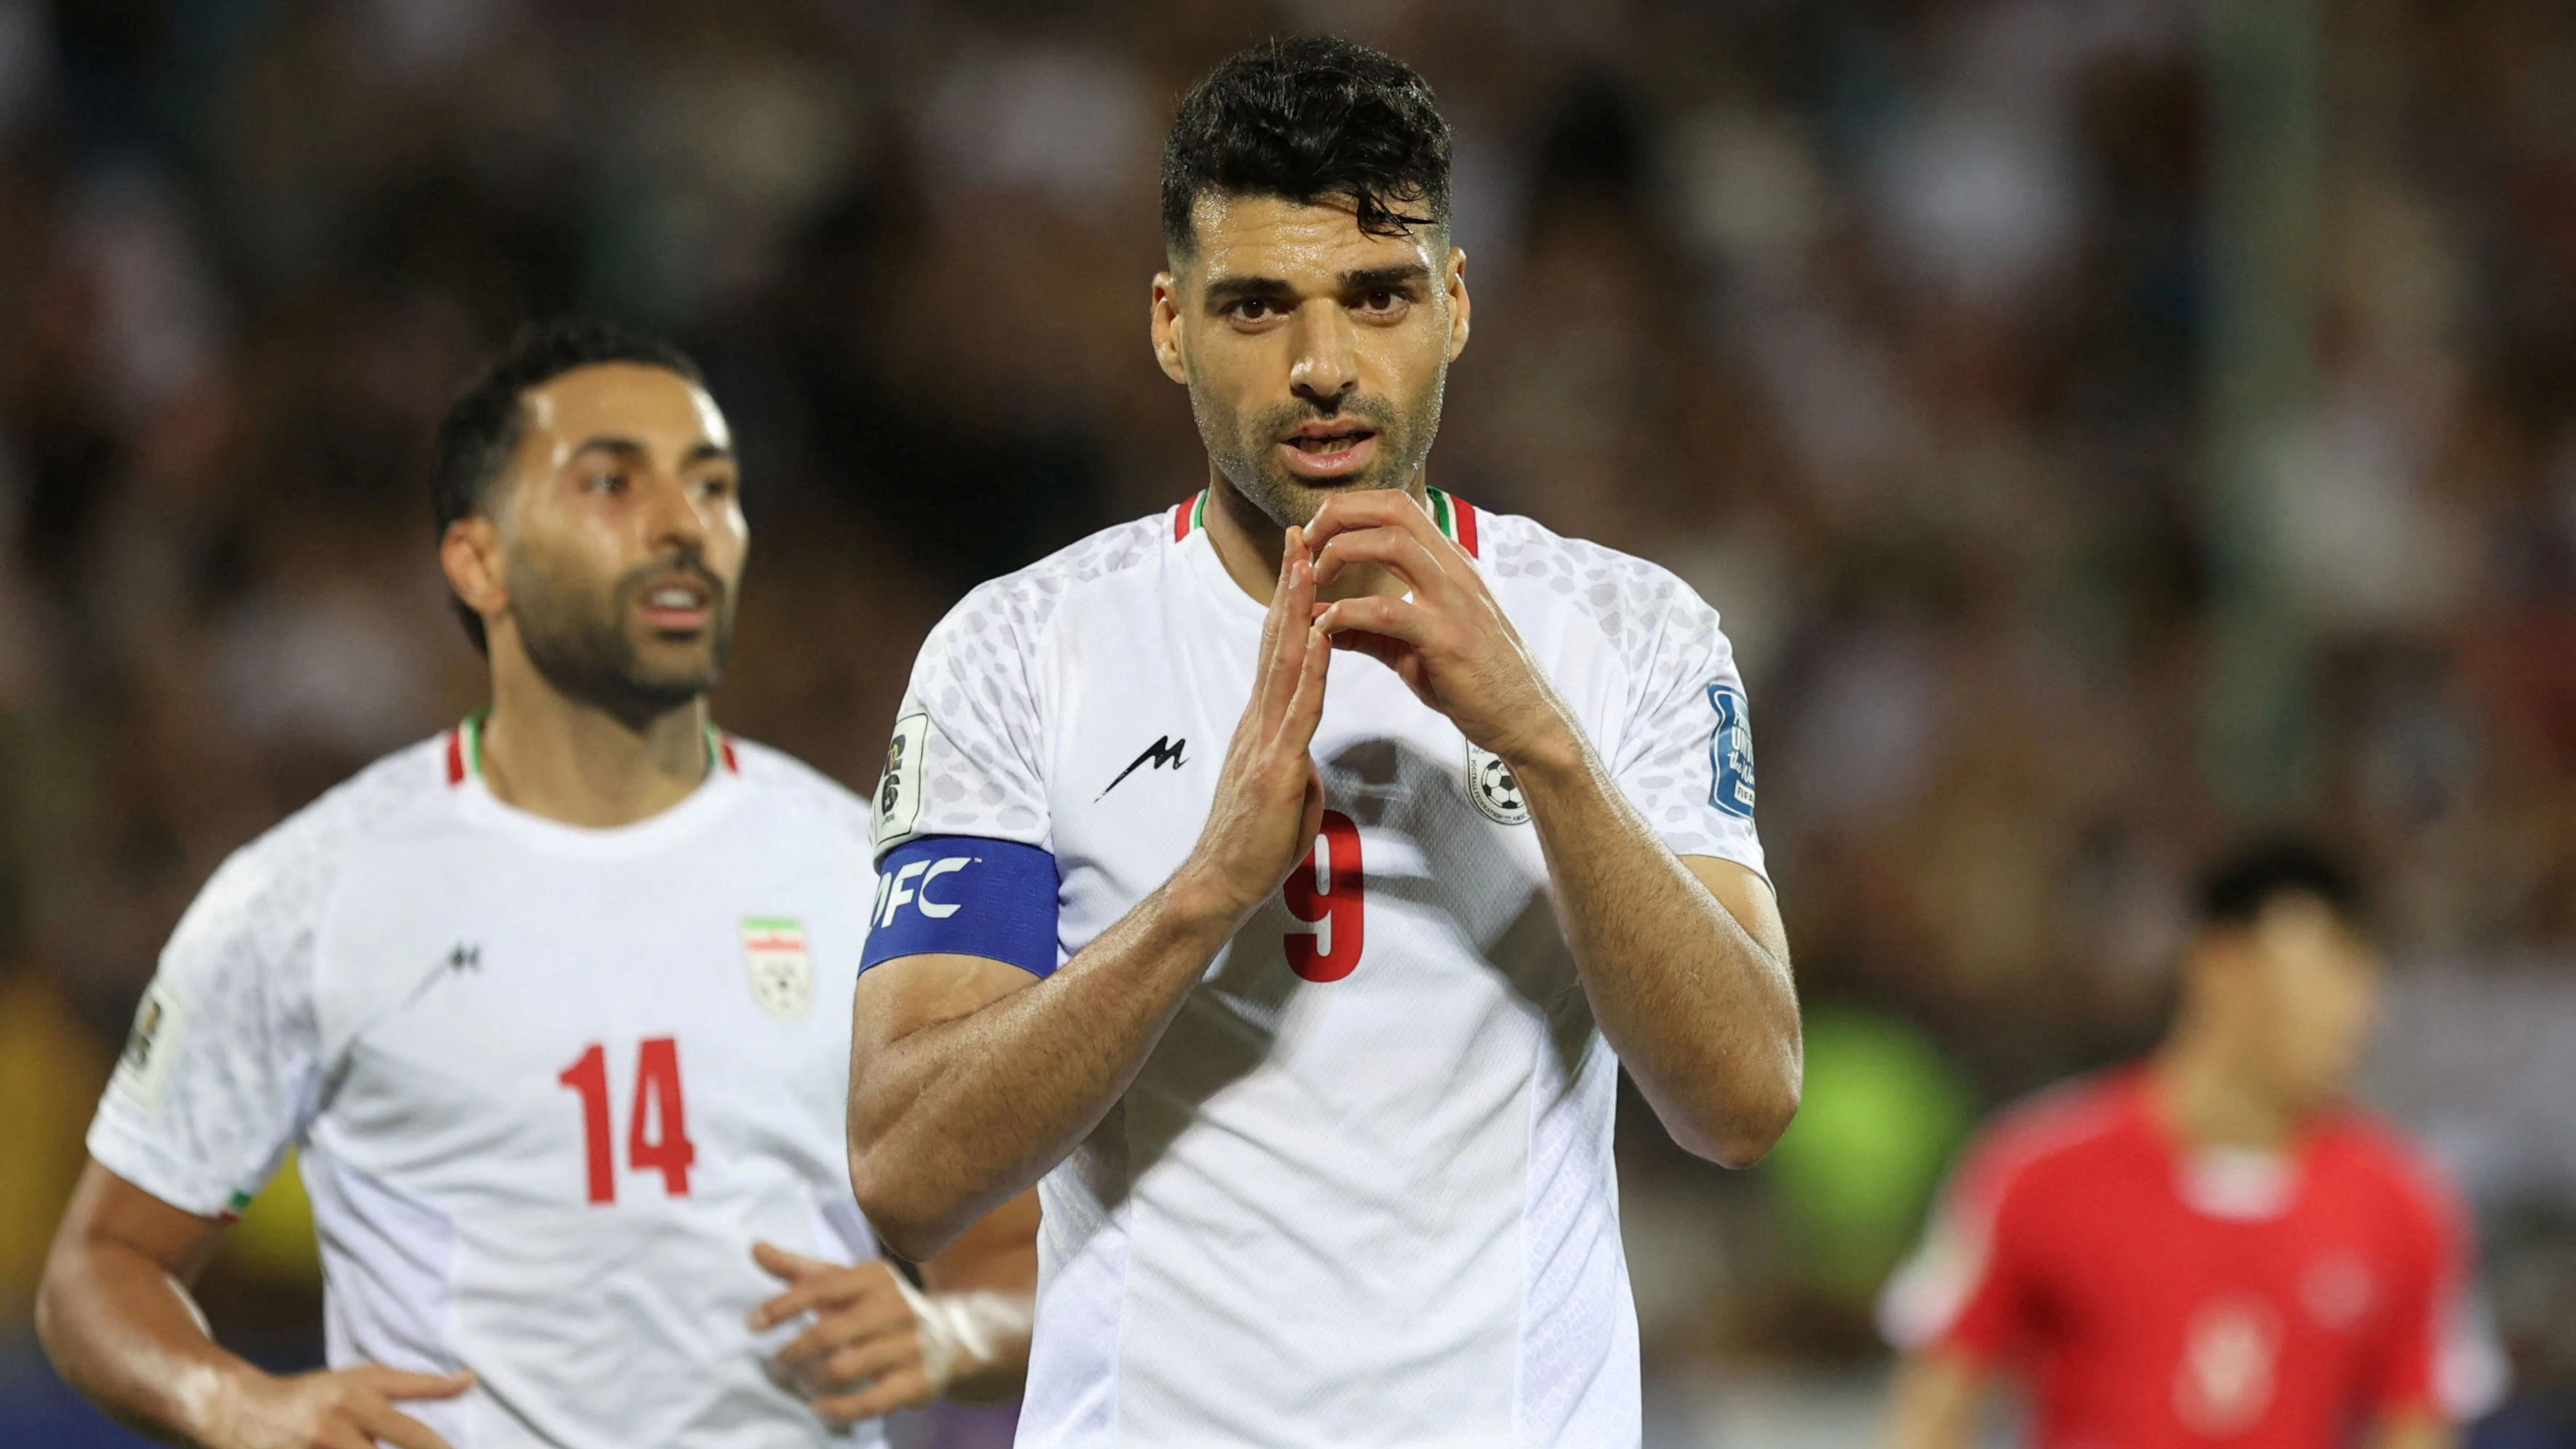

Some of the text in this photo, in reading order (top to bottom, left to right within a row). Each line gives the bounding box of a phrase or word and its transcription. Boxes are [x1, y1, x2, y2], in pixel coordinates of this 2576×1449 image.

[1471, 759, 1479, 793] FOOTBALL
[1474, 791, 1503, 820] FEDERATION
[1737, 786, 1754, 803] FIFA
[1283, 810, 1364, 982] 9
[559, 1036, 695, 1206] 14
